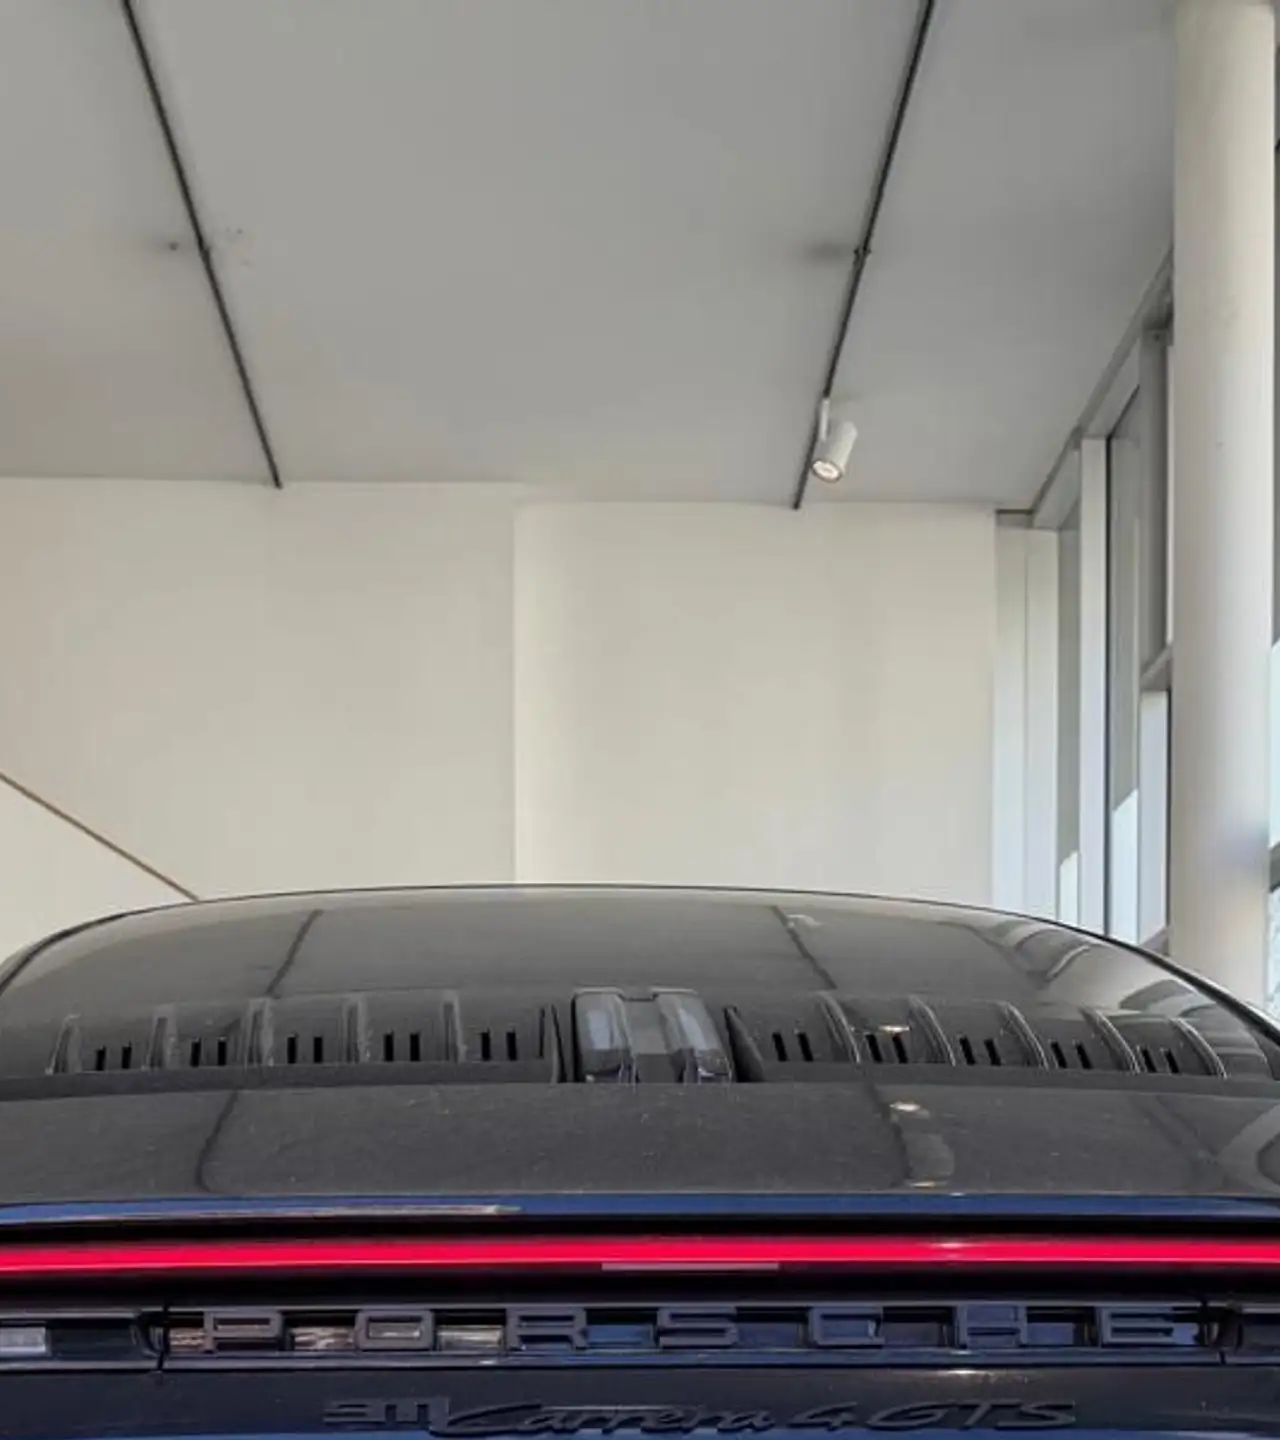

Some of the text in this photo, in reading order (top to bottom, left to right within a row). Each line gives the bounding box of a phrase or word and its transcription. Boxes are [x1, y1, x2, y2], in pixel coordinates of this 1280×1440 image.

[203, 1308, 1176, 1352] PORSCHE
[323, 1397, 1076, 1438] 911 Carrera 4 GTS
